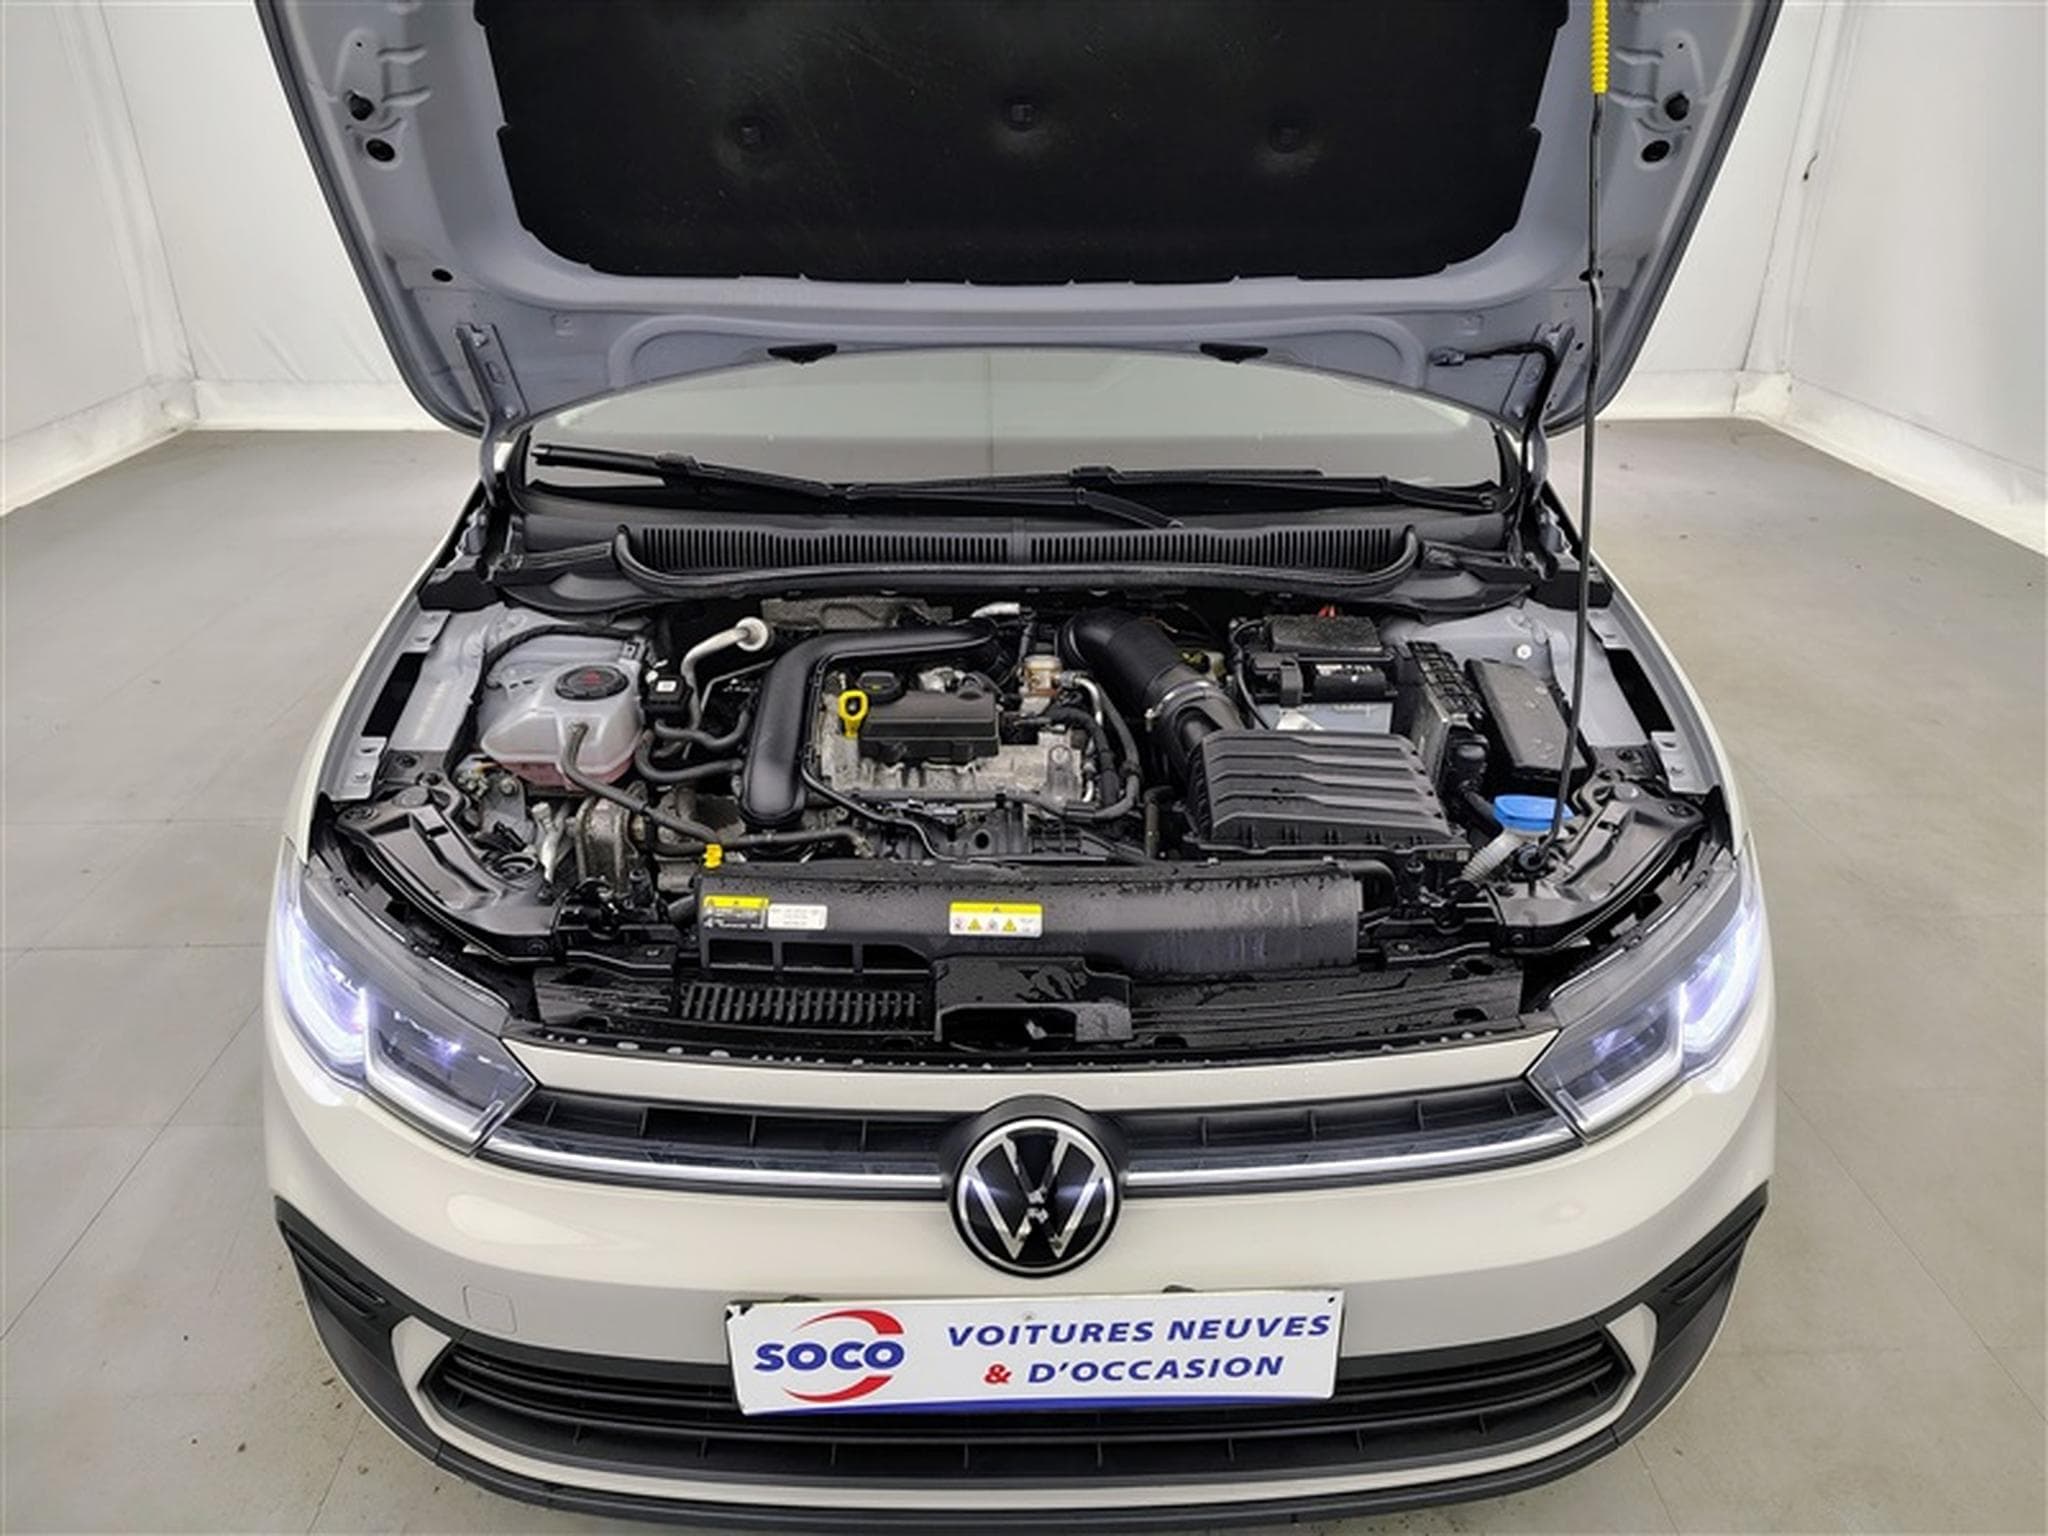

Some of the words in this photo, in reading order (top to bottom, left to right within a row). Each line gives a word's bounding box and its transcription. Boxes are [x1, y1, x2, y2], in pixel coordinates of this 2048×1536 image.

[948, 1320, 1154, 1348] VOITURES
[1166, 1314, 1332, 1341] NEUVES
[754, 1339, 905, 1373] SOCO
[983, 1363, 1011, 1385] &
[1026, 1354, 1285, 1385] D'OCCASION
